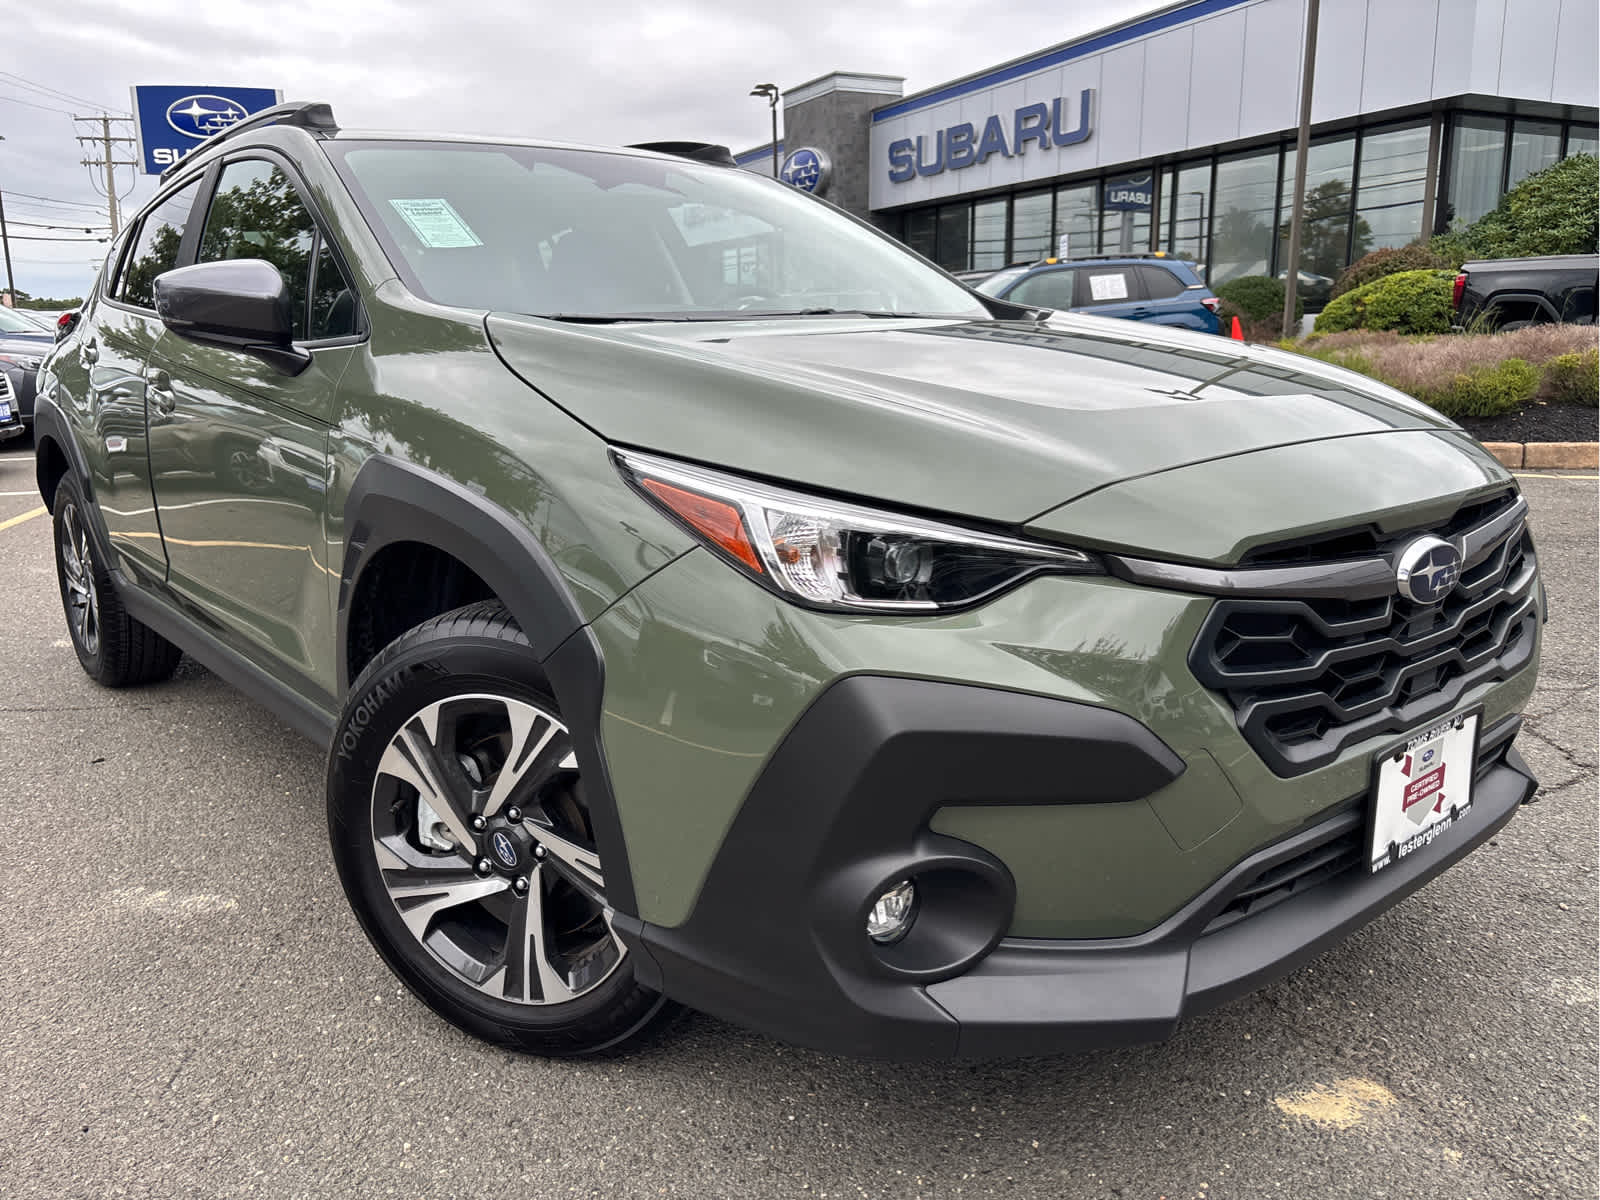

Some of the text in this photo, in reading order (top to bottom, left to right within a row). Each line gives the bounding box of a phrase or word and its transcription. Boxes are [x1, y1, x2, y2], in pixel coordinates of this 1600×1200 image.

[888, 88, 1092, 183] SUBARU
[153, 148, 194, 165] SU
[337, 667, 413, 760] YOKOHAMA
[1406, 780, 1441, 805] PRE-OWNED
[1410, 772, 1439, 793] CERTIFIED
[1398, 818, 1452, 859] lesterglenn
